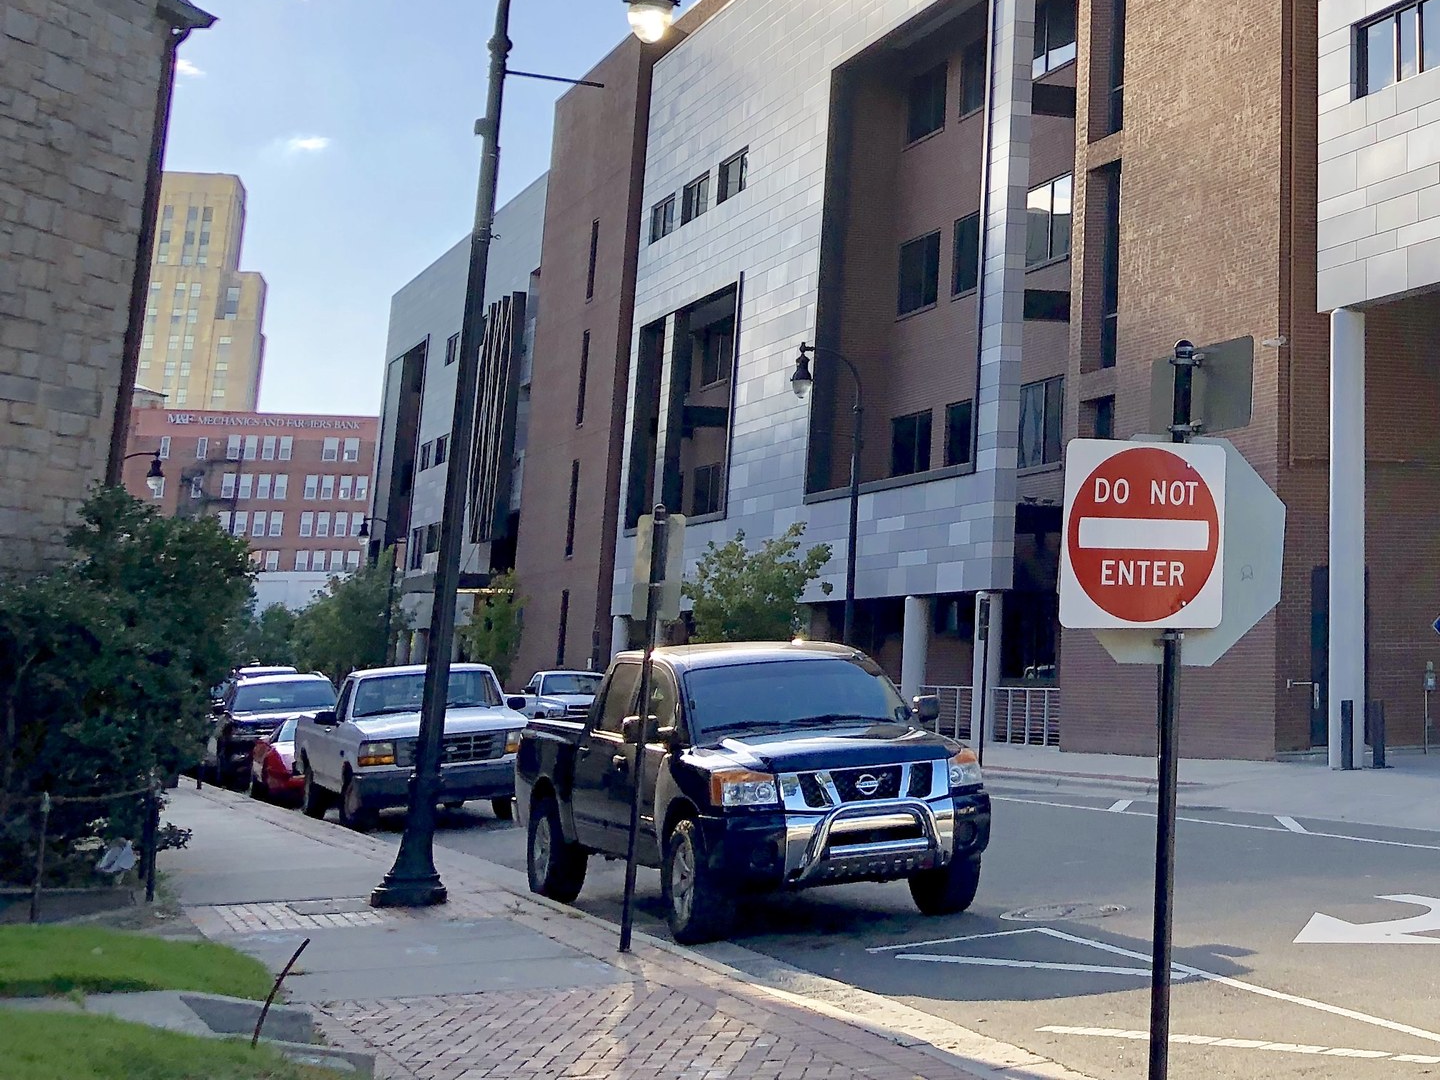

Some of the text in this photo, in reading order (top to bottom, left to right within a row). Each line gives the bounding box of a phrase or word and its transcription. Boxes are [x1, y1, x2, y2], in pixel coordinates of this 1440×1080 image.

[198, 416, 259, 427] MECHANICS
[263, 418, 284, 427] AND
[334, 421, 360, 429] BANK
[1094, 477, 1199, 507] DO NOT
[1101, 559, 1185, 587] ENTER
